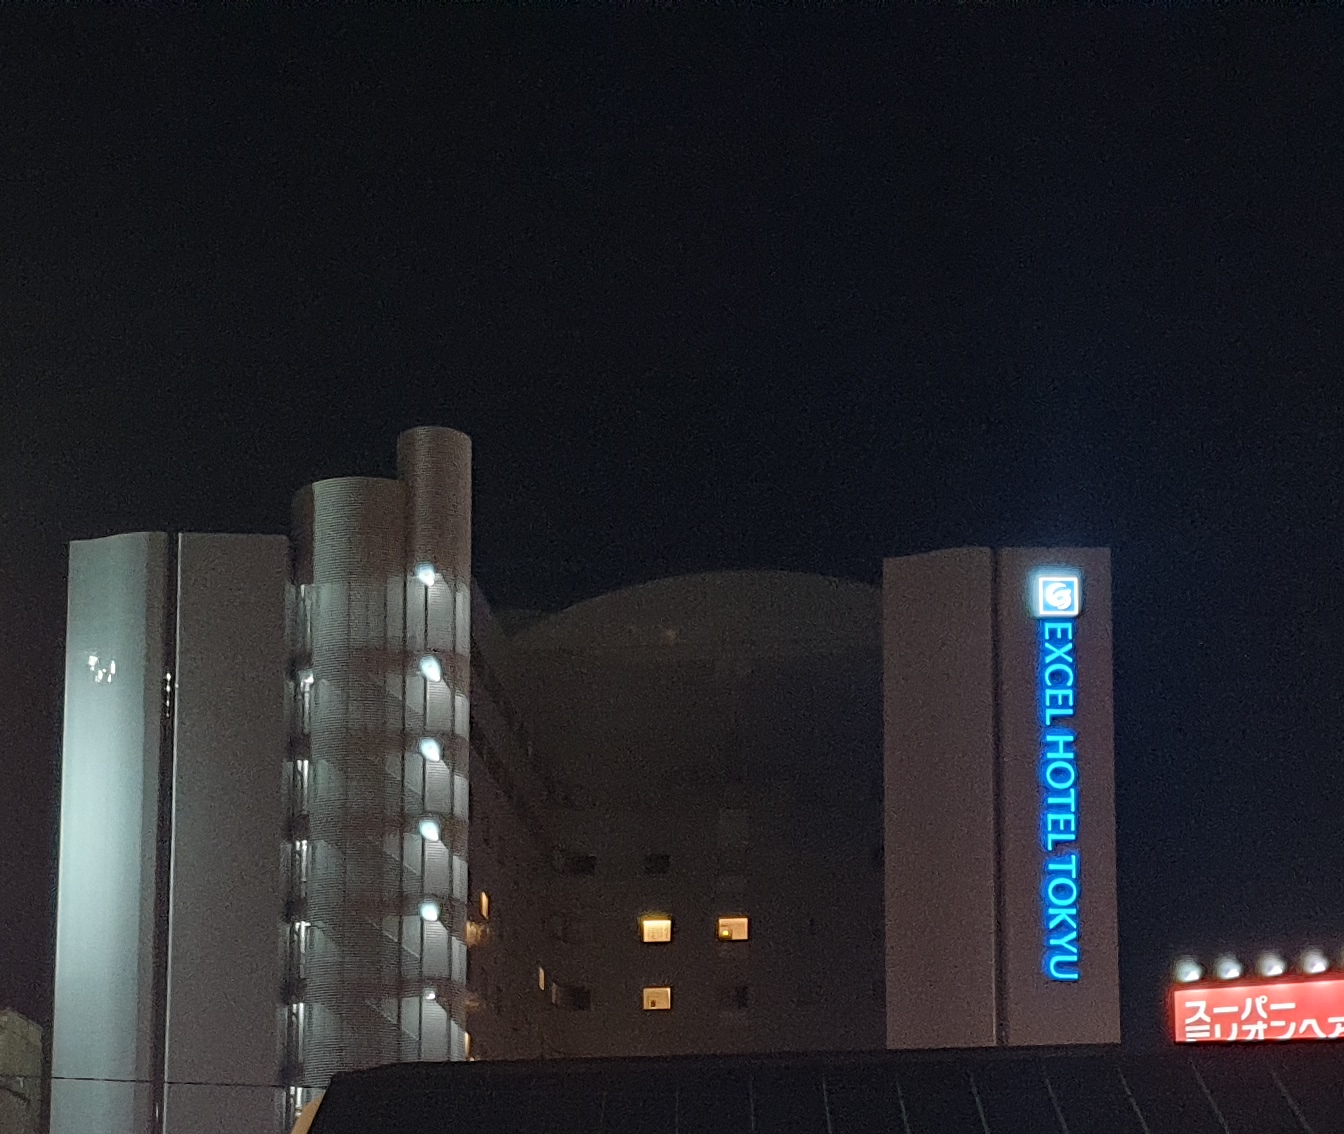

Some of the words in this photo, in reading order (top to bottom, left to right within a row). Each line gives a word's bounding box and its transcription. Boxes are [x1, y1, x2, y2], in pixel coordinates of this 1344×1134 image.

[1044, 620, 1075, 726] EXCEL
[1045, 734, 1078, 852] HOTEL
[1047, 854, 1080, 982] TOKYU
[1184, 994, 1297, 1025] スーパー
